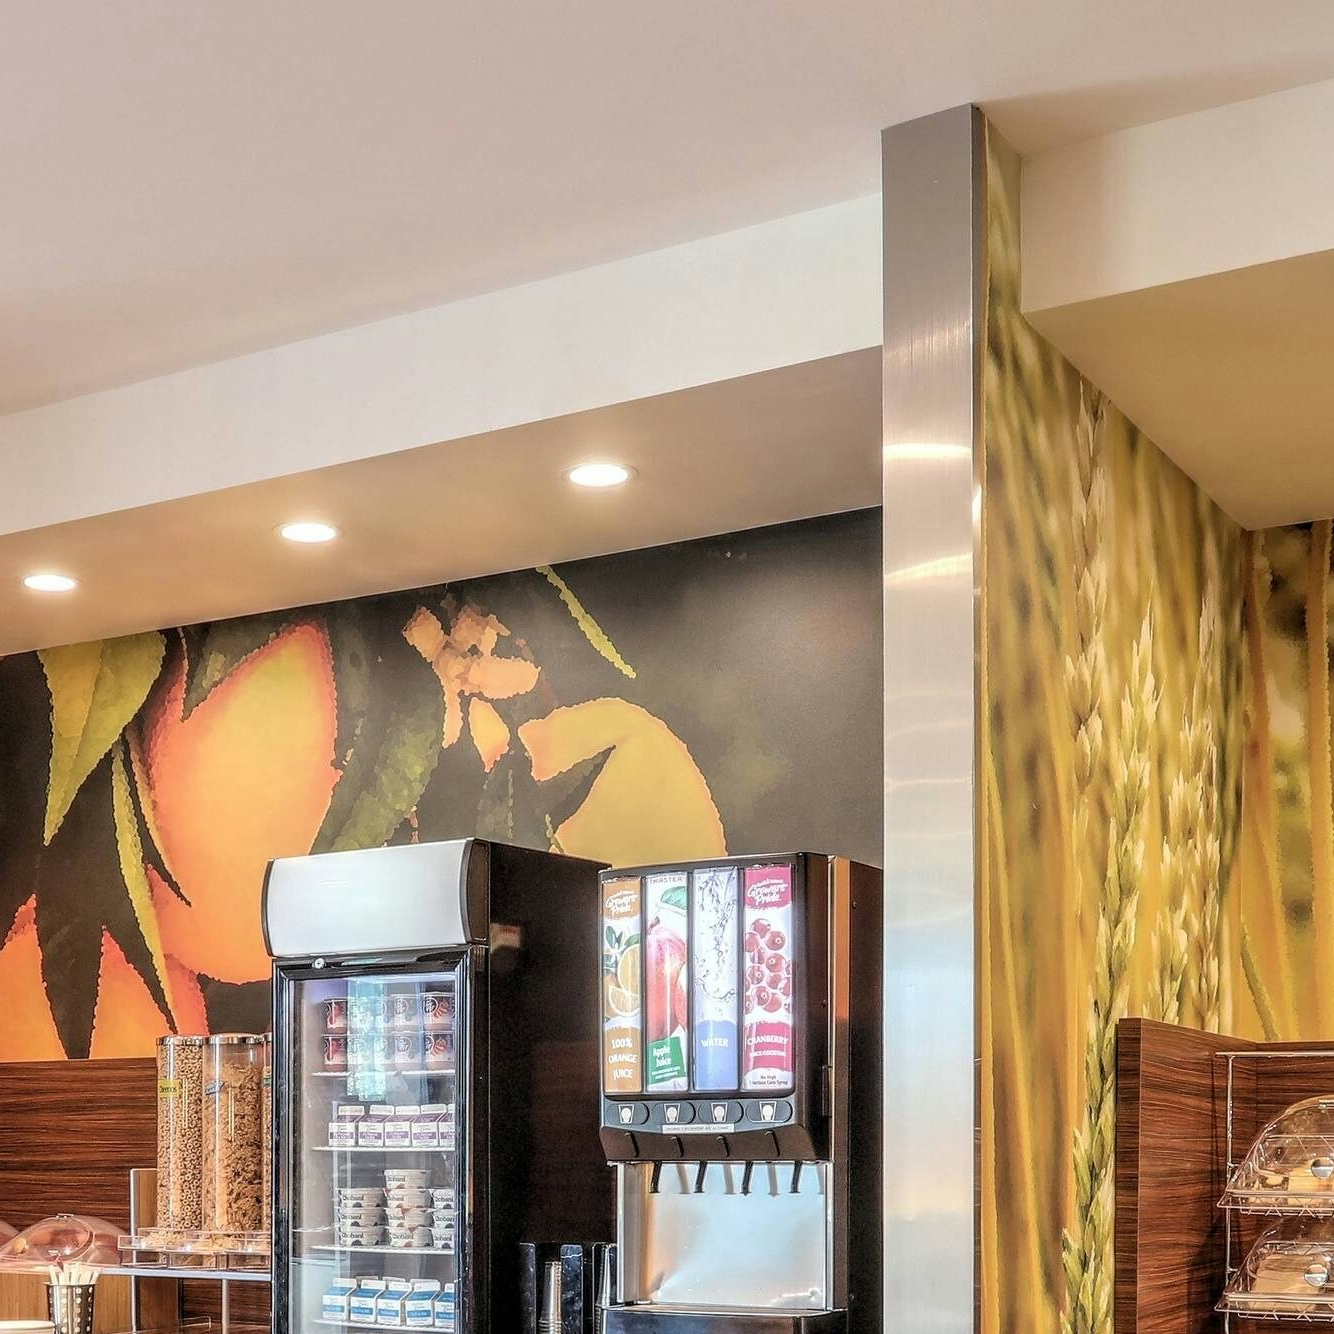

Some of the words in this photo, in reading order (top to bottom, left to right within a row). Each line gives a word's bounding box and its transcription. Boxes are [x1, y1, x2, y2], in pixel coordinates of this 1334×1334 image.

[611, 1037, 633, 1049] 100%
[700, 1037, 729, 1048] WATER
[747, 1035, 788, 1046] CRANBERRY
[652, 1045, 671, 1057] Apple
[608, 1053, 638, 1064] ORANGE
